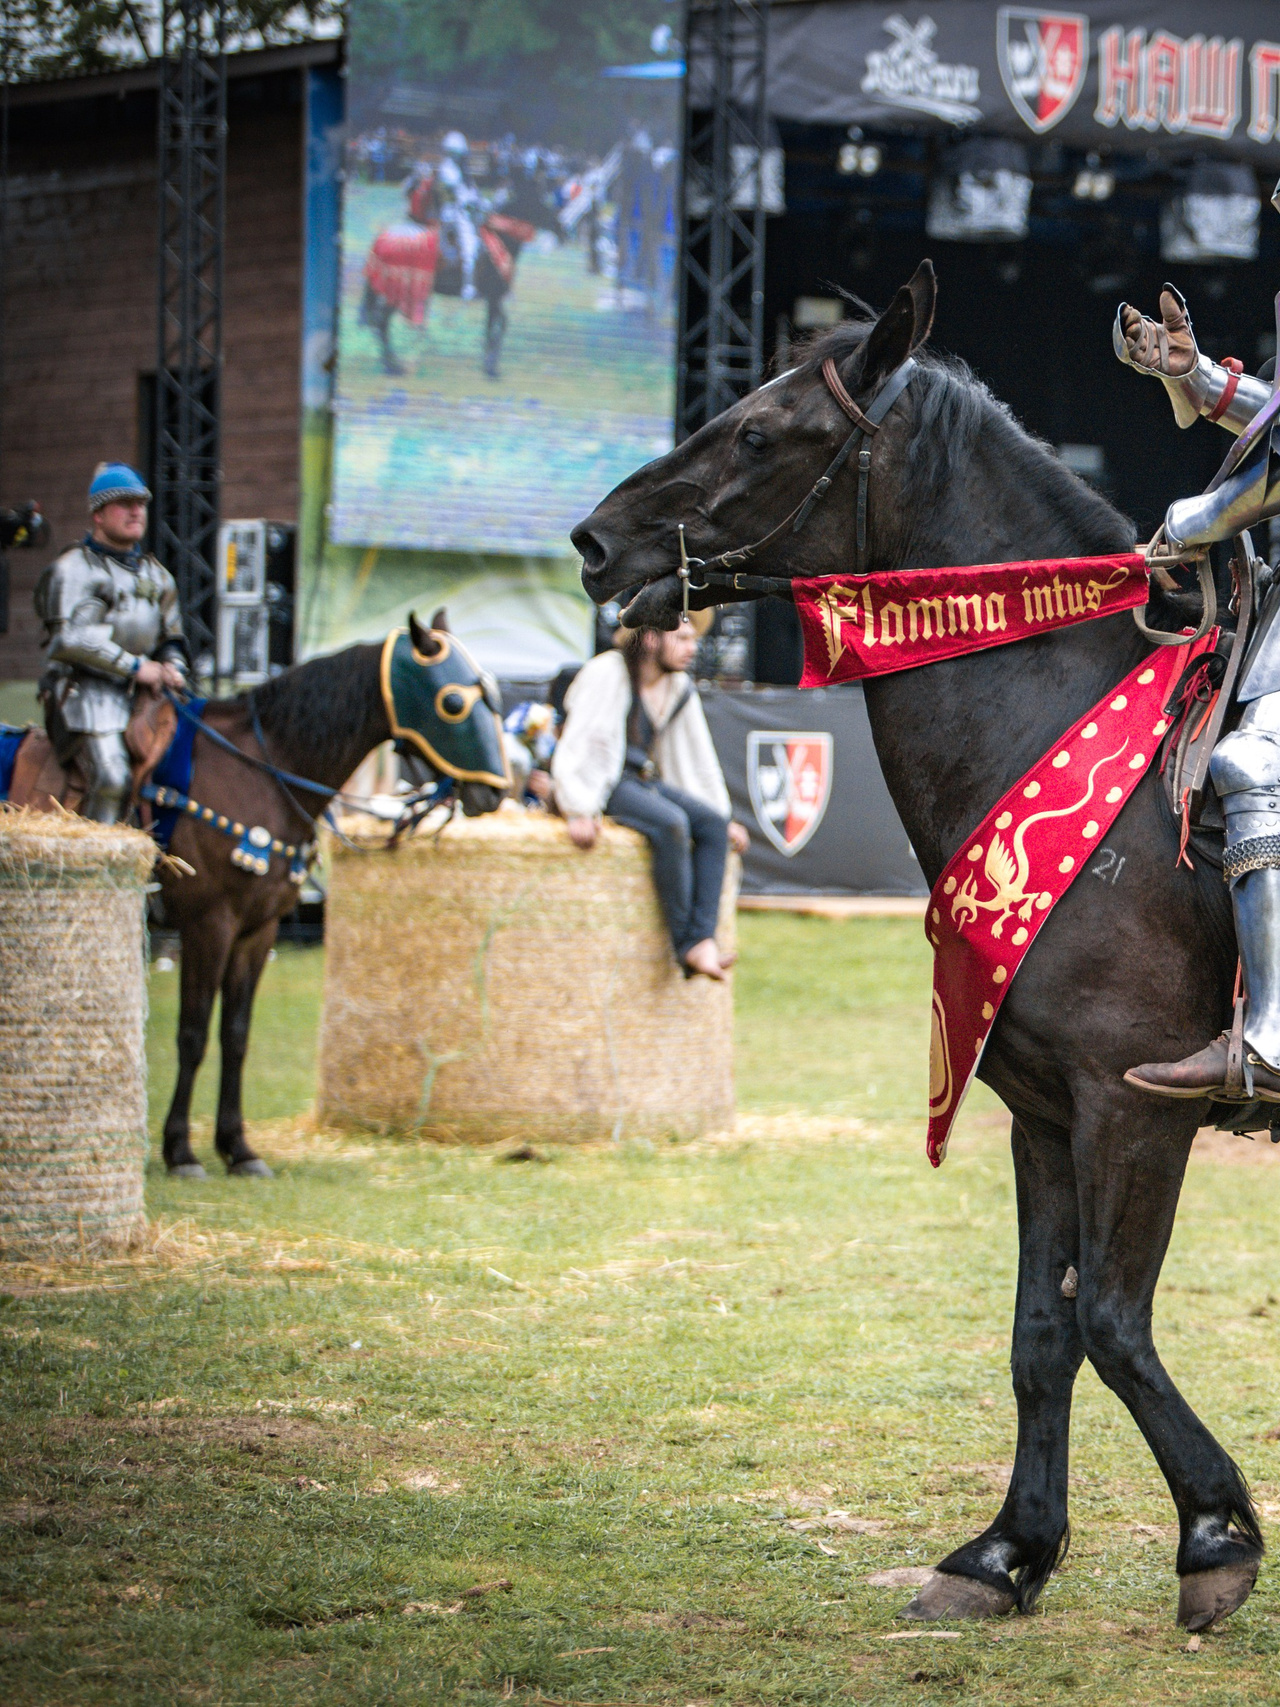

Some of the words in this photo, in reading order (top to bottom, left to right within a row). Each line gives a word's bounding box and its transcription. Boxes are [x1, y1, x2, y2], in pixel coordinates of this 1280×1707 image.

[1094, 24, 1244, 140] НАШ
[815, 582, 1008, 677] Flamma
[1021, 567, 1130, 624] intus
[1092, 848, 1126, 885] 21
